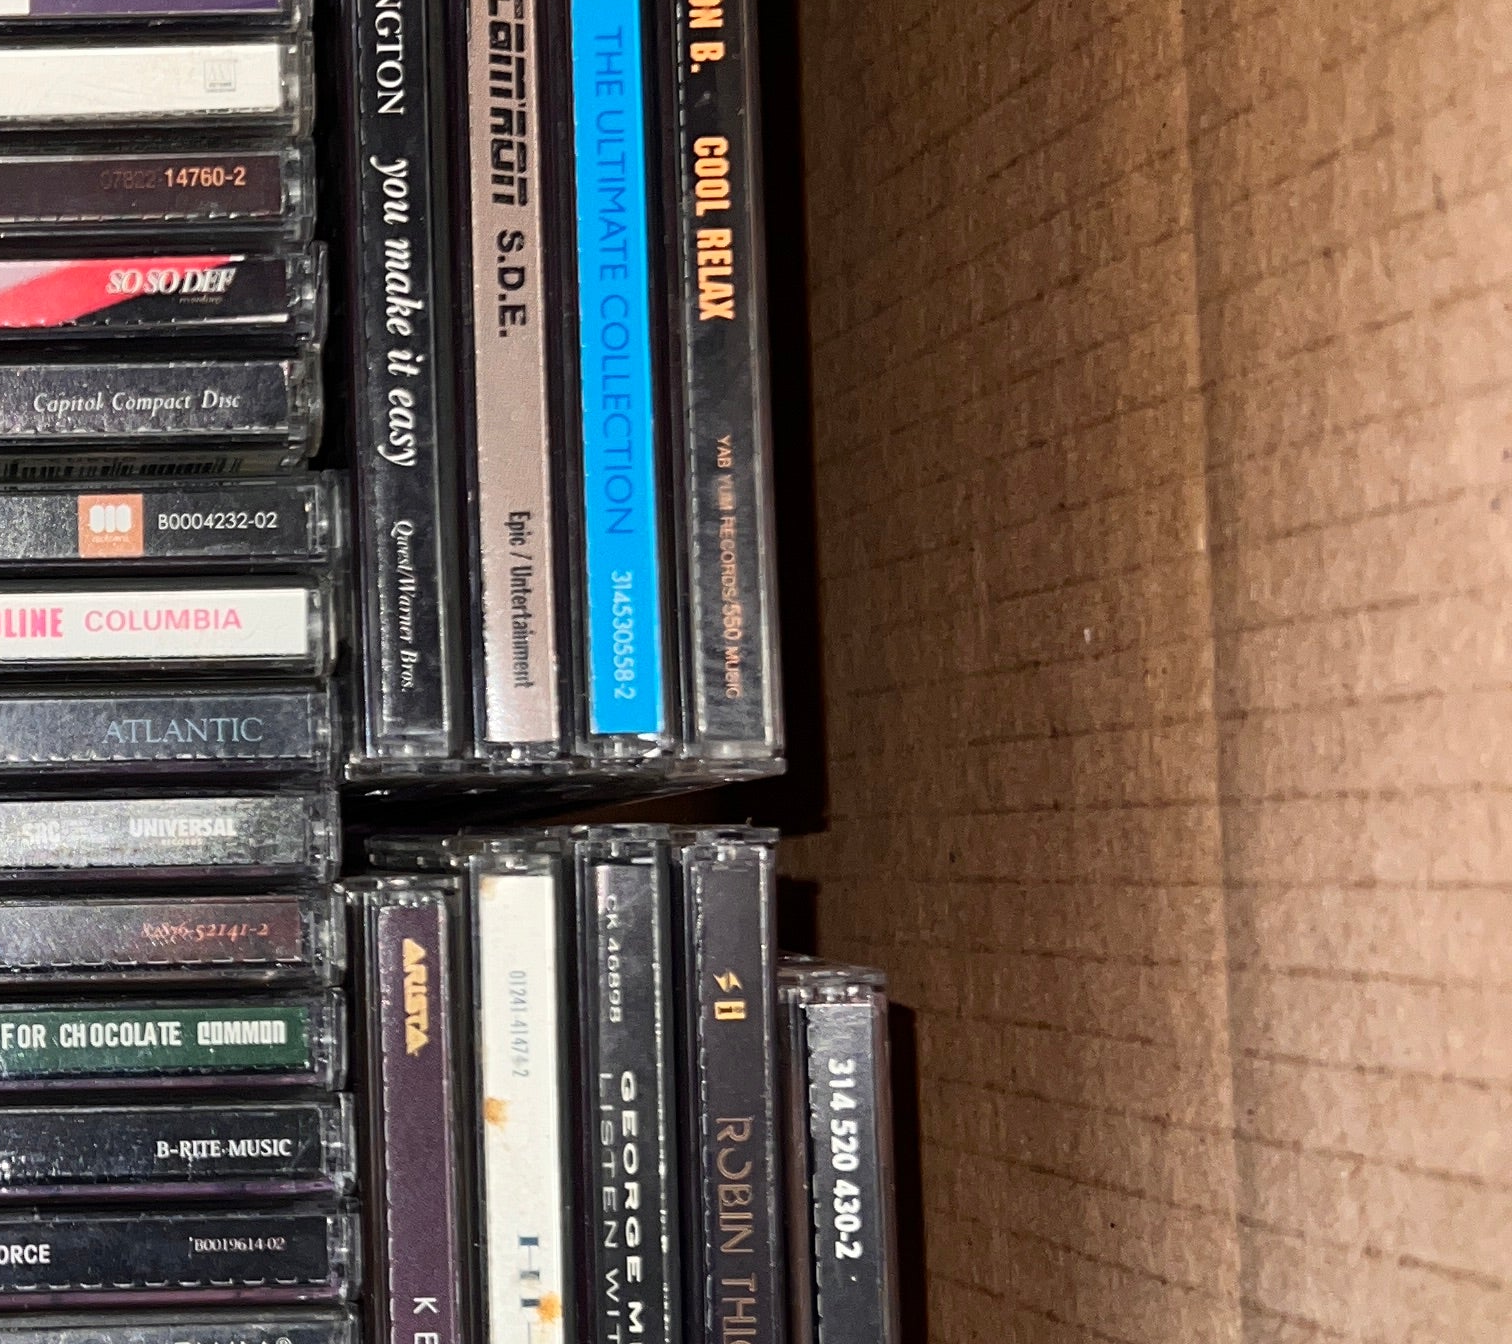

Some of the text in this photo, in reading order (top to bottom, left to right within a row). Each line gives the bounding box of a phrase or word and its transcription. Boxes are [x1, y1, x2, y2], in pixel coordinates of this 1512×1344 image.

[694, 137, 734, 320] COOL RELAX
[179, 267, 236, 294] DEF
[384, 239, 424, 336] make
[496, 230, 525, 337] S.D.E.
[595, 111, 634, 535] ULTIMATE COLLECTION
[113, 391, 191, 414] Compact
[378, 388, 416, 466] easy
[158, 512, 278, 530] B0004232-02
[85, 608, 241, 632] COLUMBIA
[389, 519, 414, 644] Qwest/Warner
[510, 566, 535, 688] Untertainment
[611, 571, 635, 699] 314530558-2
[725, 646, 742, 698] MUSIC
[103, 718, 263, 743] ATLANTIC
[129, 817, 237, 839] UNIVERSAL
[403, 938, 429, 1055] ARISTA
[607, 939, 622, 1023] 46898
[60, 1023, 182, 1046] CHOCOLATE
[601, 1072, 617, 1249] LISTEN
[621, 1071, 642, 1282] GEORGE
[716, 1116, 752, 1254] ROBIN
[833, 1181, 862, 1260] 430-2
